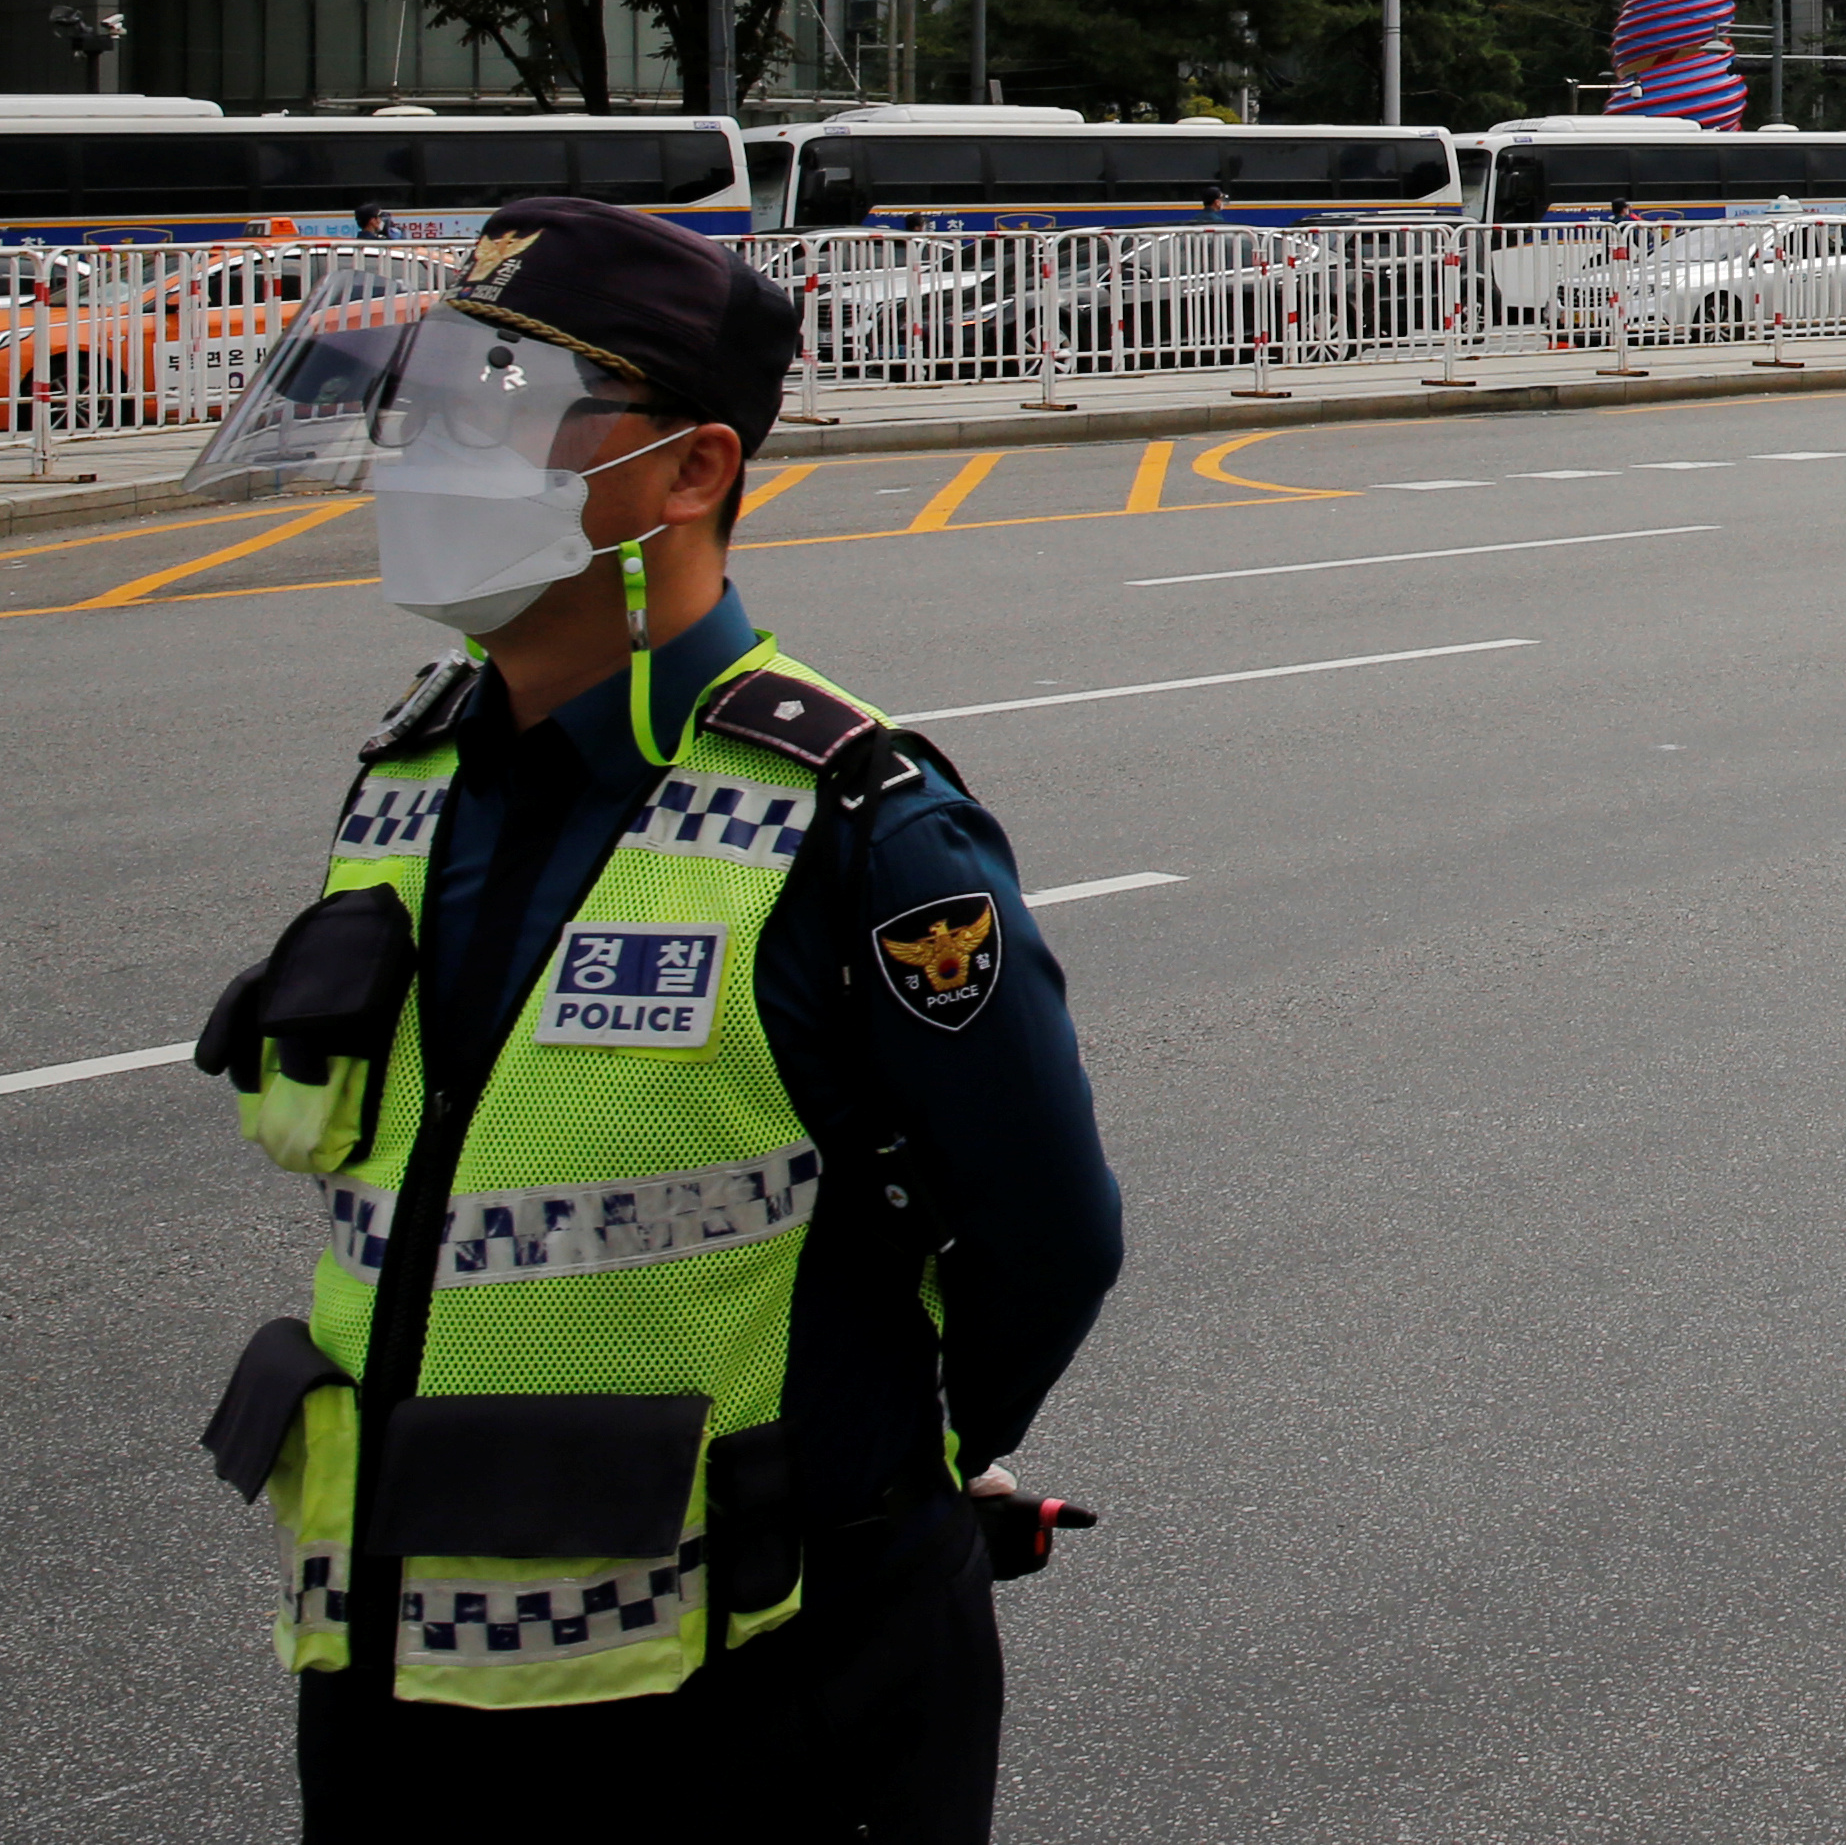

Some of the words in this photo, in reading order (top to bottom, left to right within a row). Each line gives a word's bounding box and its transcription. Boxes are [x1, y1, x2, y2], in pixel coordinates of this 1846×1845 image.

[571, 936, 707, 994] 경찰
[926, 984, 980, 1009] POLICE
[555, 1002, 695, 1032] POLICE
